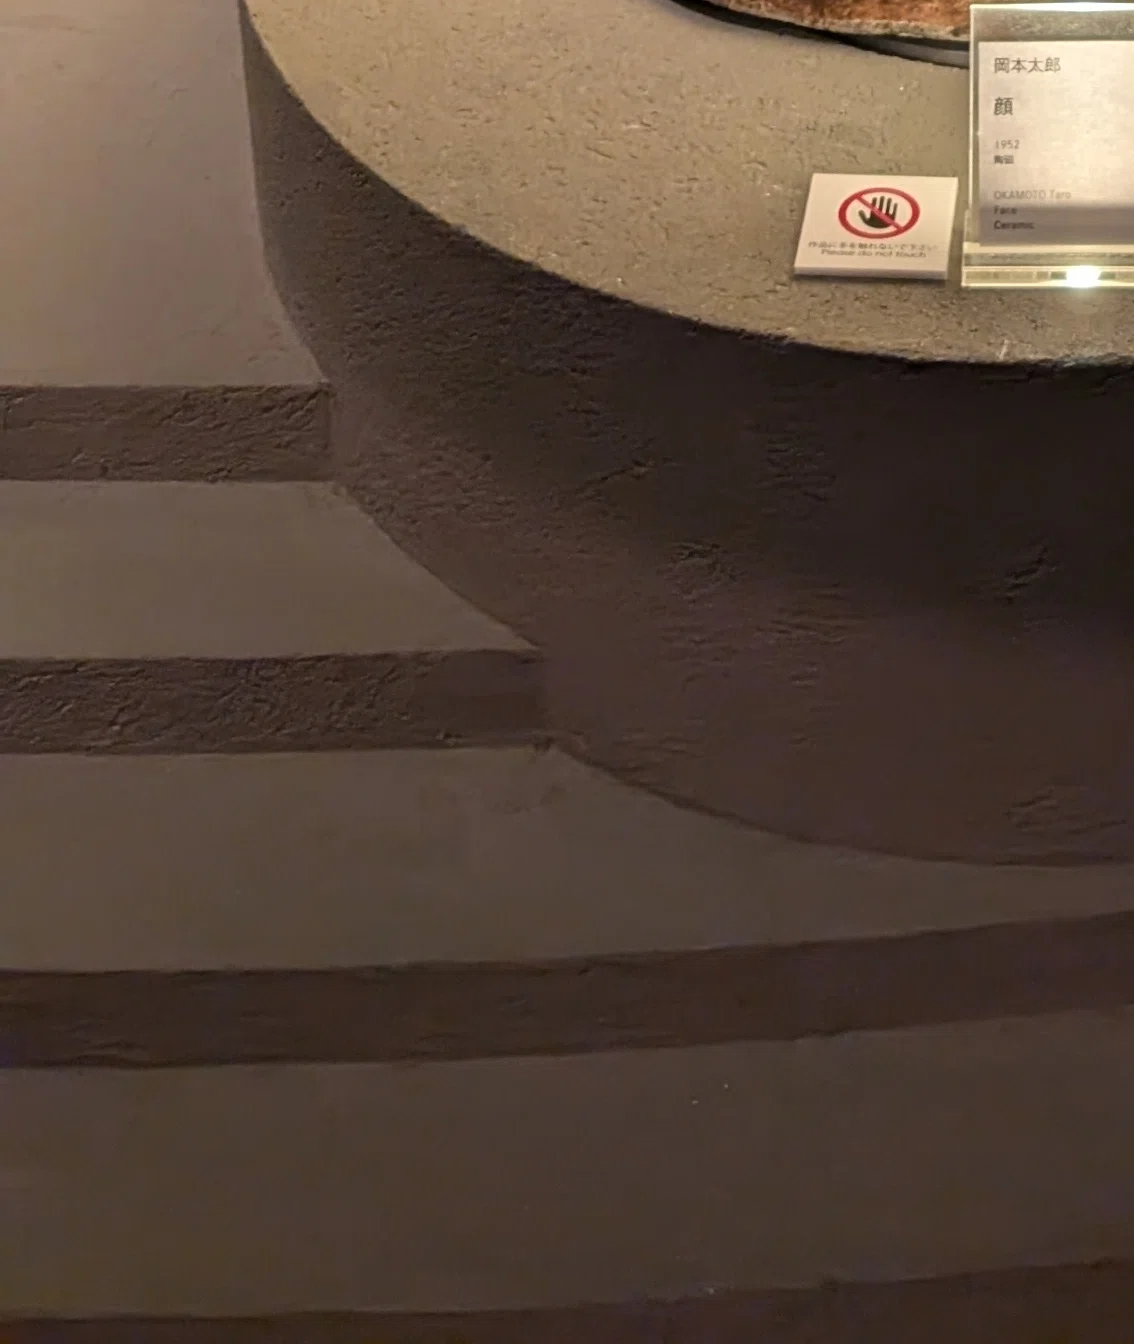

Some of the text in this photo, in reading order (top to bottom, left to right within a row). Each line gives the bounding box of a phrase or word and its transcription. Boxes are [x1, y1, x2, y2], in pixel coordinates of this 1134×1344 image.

[993, 57, 1062, 73] 岡本太郎
[993, 97, 1014, 116] 顔
[995, 139, 1020, 150] 1952
[994, 190, 1047, 200] OKAMOTO
[821, 248, 856, 256] Please
[858, 249, 873, 257] do
